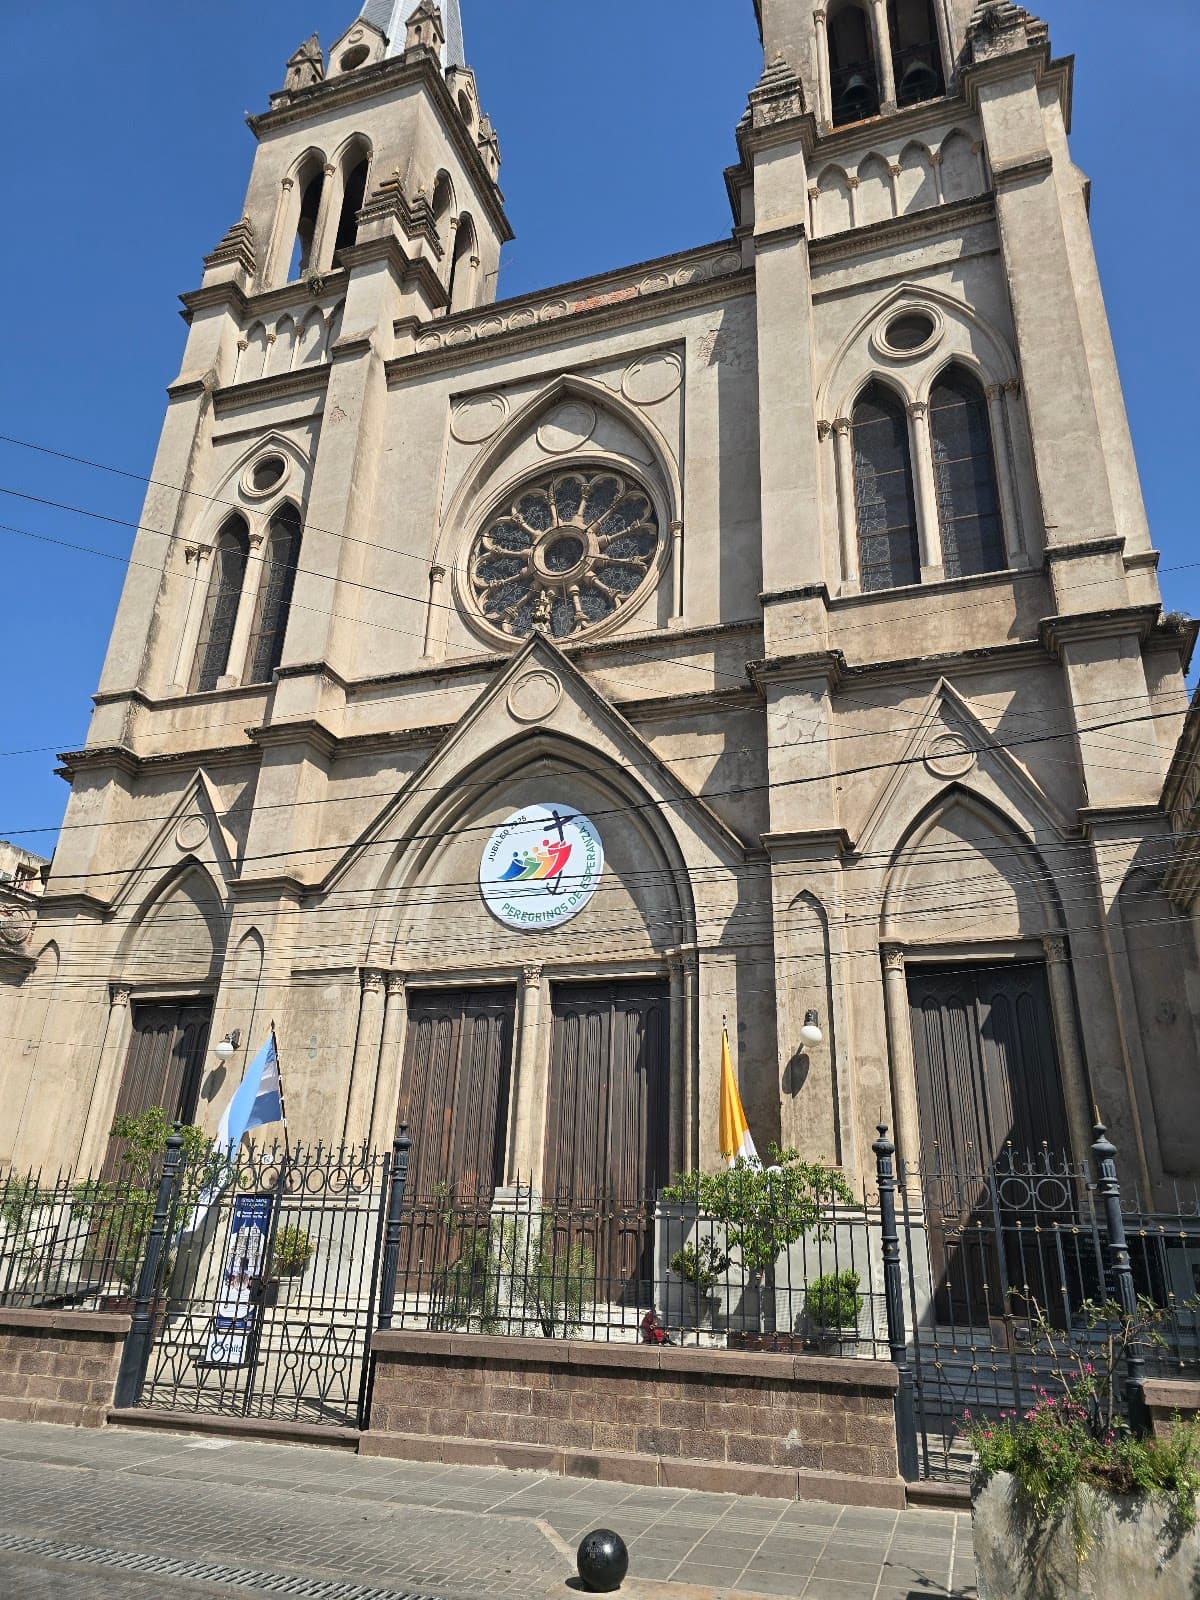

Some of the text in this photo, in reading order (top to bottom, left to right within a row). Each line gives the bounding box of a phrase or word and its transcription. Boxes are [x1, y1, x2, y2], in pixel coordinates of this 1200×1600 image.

[488, 829, 509, 862] JUBILEO
[501, 825, 596, 922] PEREGRINOS DE ESPERANZA
